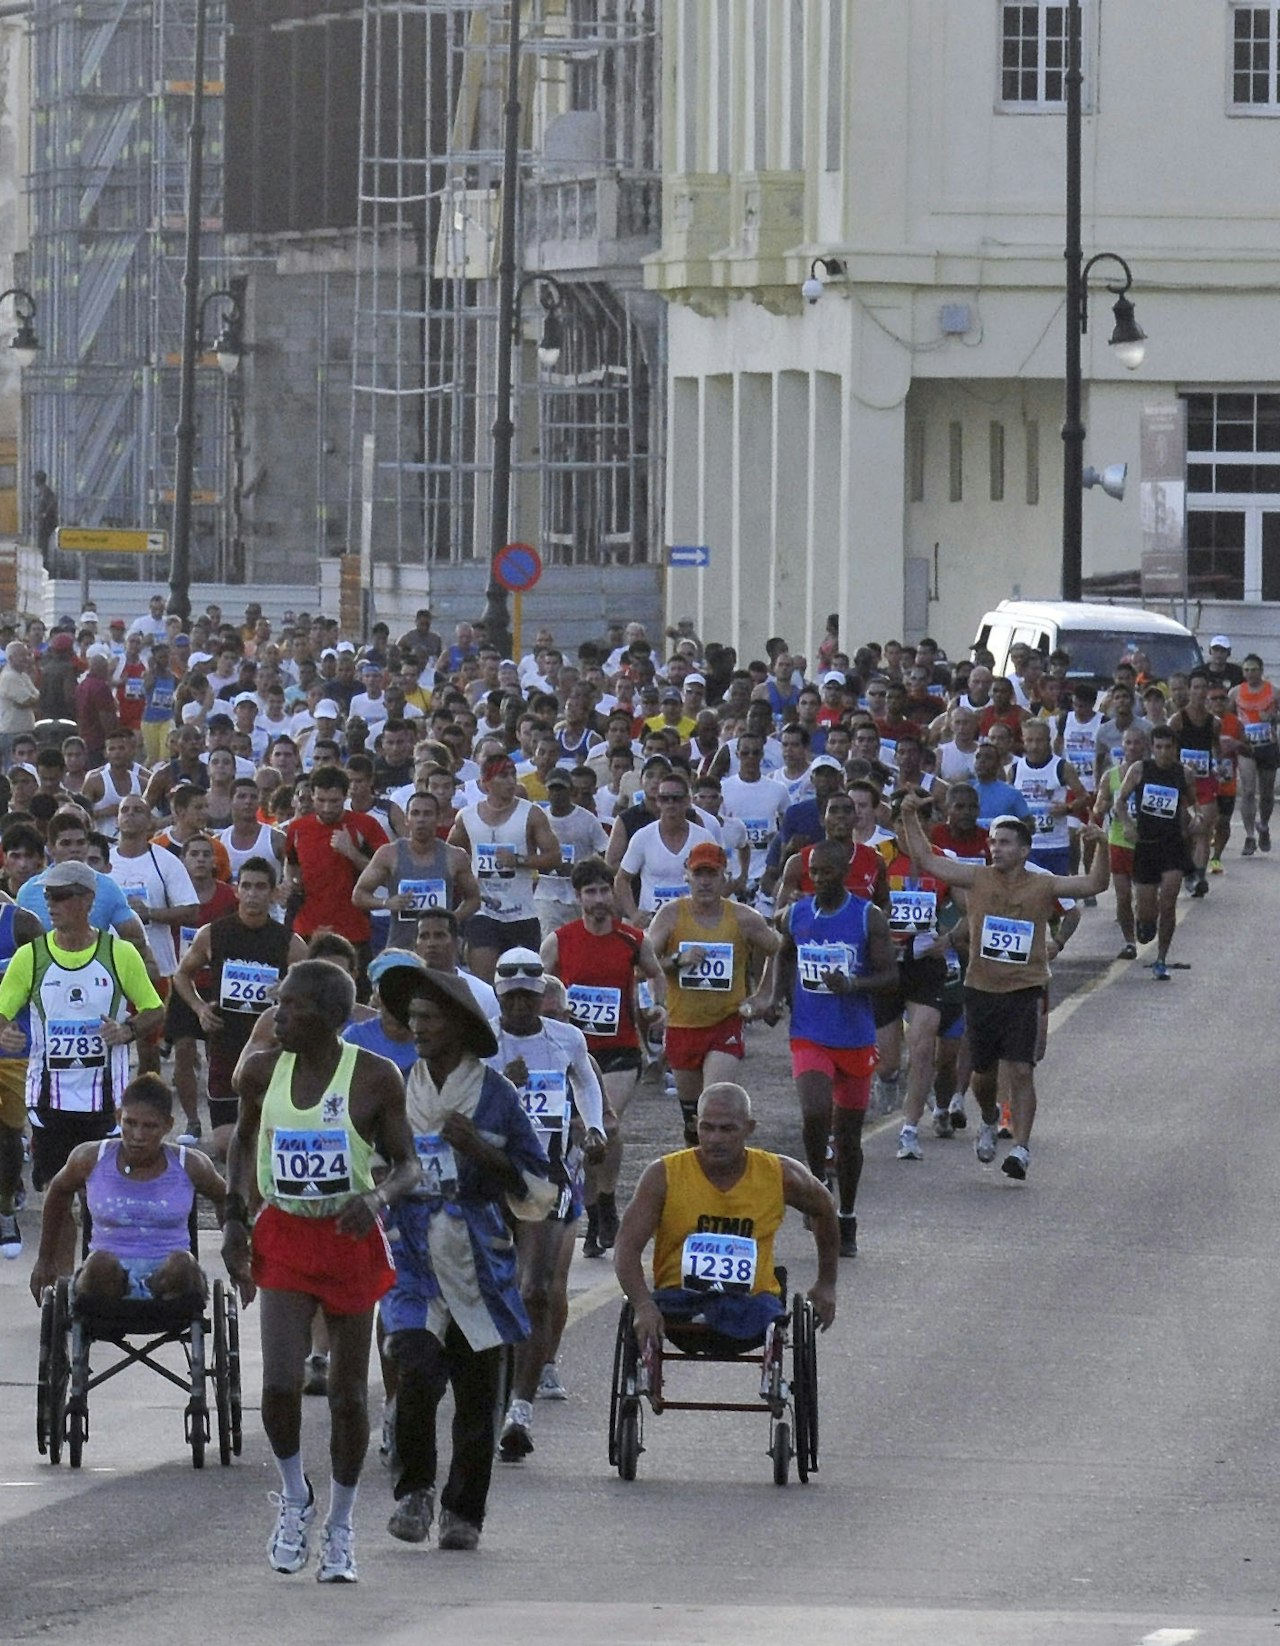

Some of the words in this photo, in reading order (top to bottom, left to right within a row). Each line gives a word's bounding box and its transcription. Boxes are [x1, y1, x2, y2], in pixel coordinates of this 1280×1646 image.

[1147, 795, 1172, 808] 287
[891, 905, 934, 921] 2304
[990, 933, 1022, 951] 591
[228, 980, 268, 1000] 266
[568, 1000, 615, 1022] 2275
[49, 1035, 104, 1057] 2783
[276, 1153, 348, 1178] 1024
[689, 1254, 753, 1281] 1238
